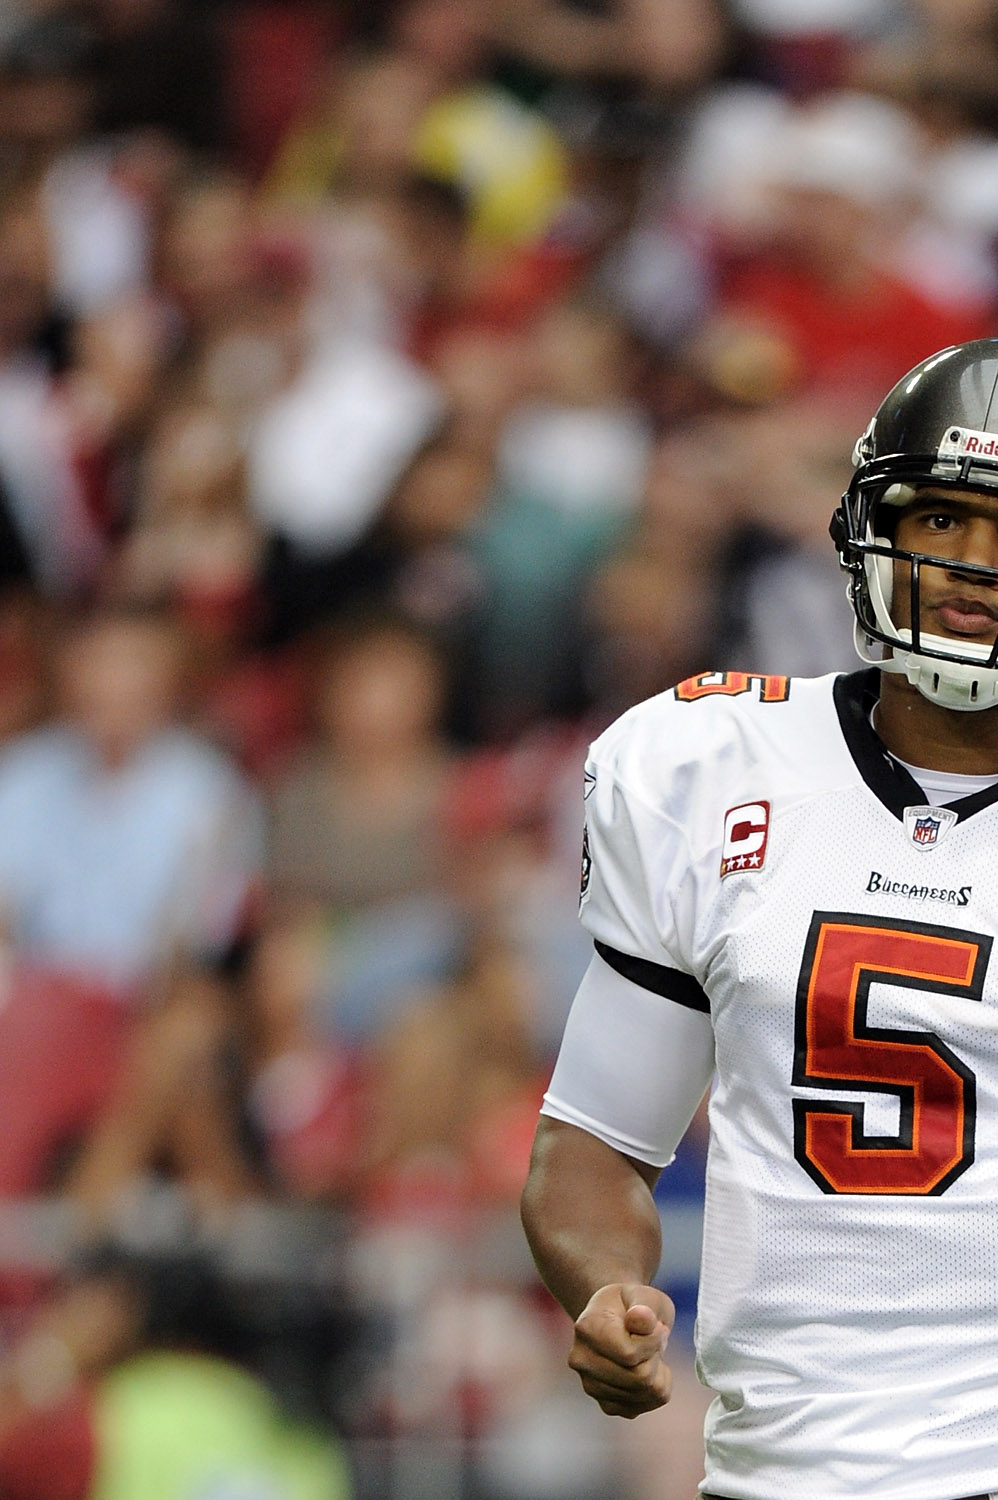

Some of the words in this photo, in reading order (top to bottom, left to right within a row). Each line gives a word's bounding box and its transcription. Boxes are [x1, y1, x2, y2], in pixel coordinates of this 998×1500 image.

[674, 671, 791, 703] 5
[724, 804, 766, 856] C
[908, 808, 953, 822] EQUIPMENT
[914, 826, 936, 842] NFL
[791, 910, 994, 1197] 5
